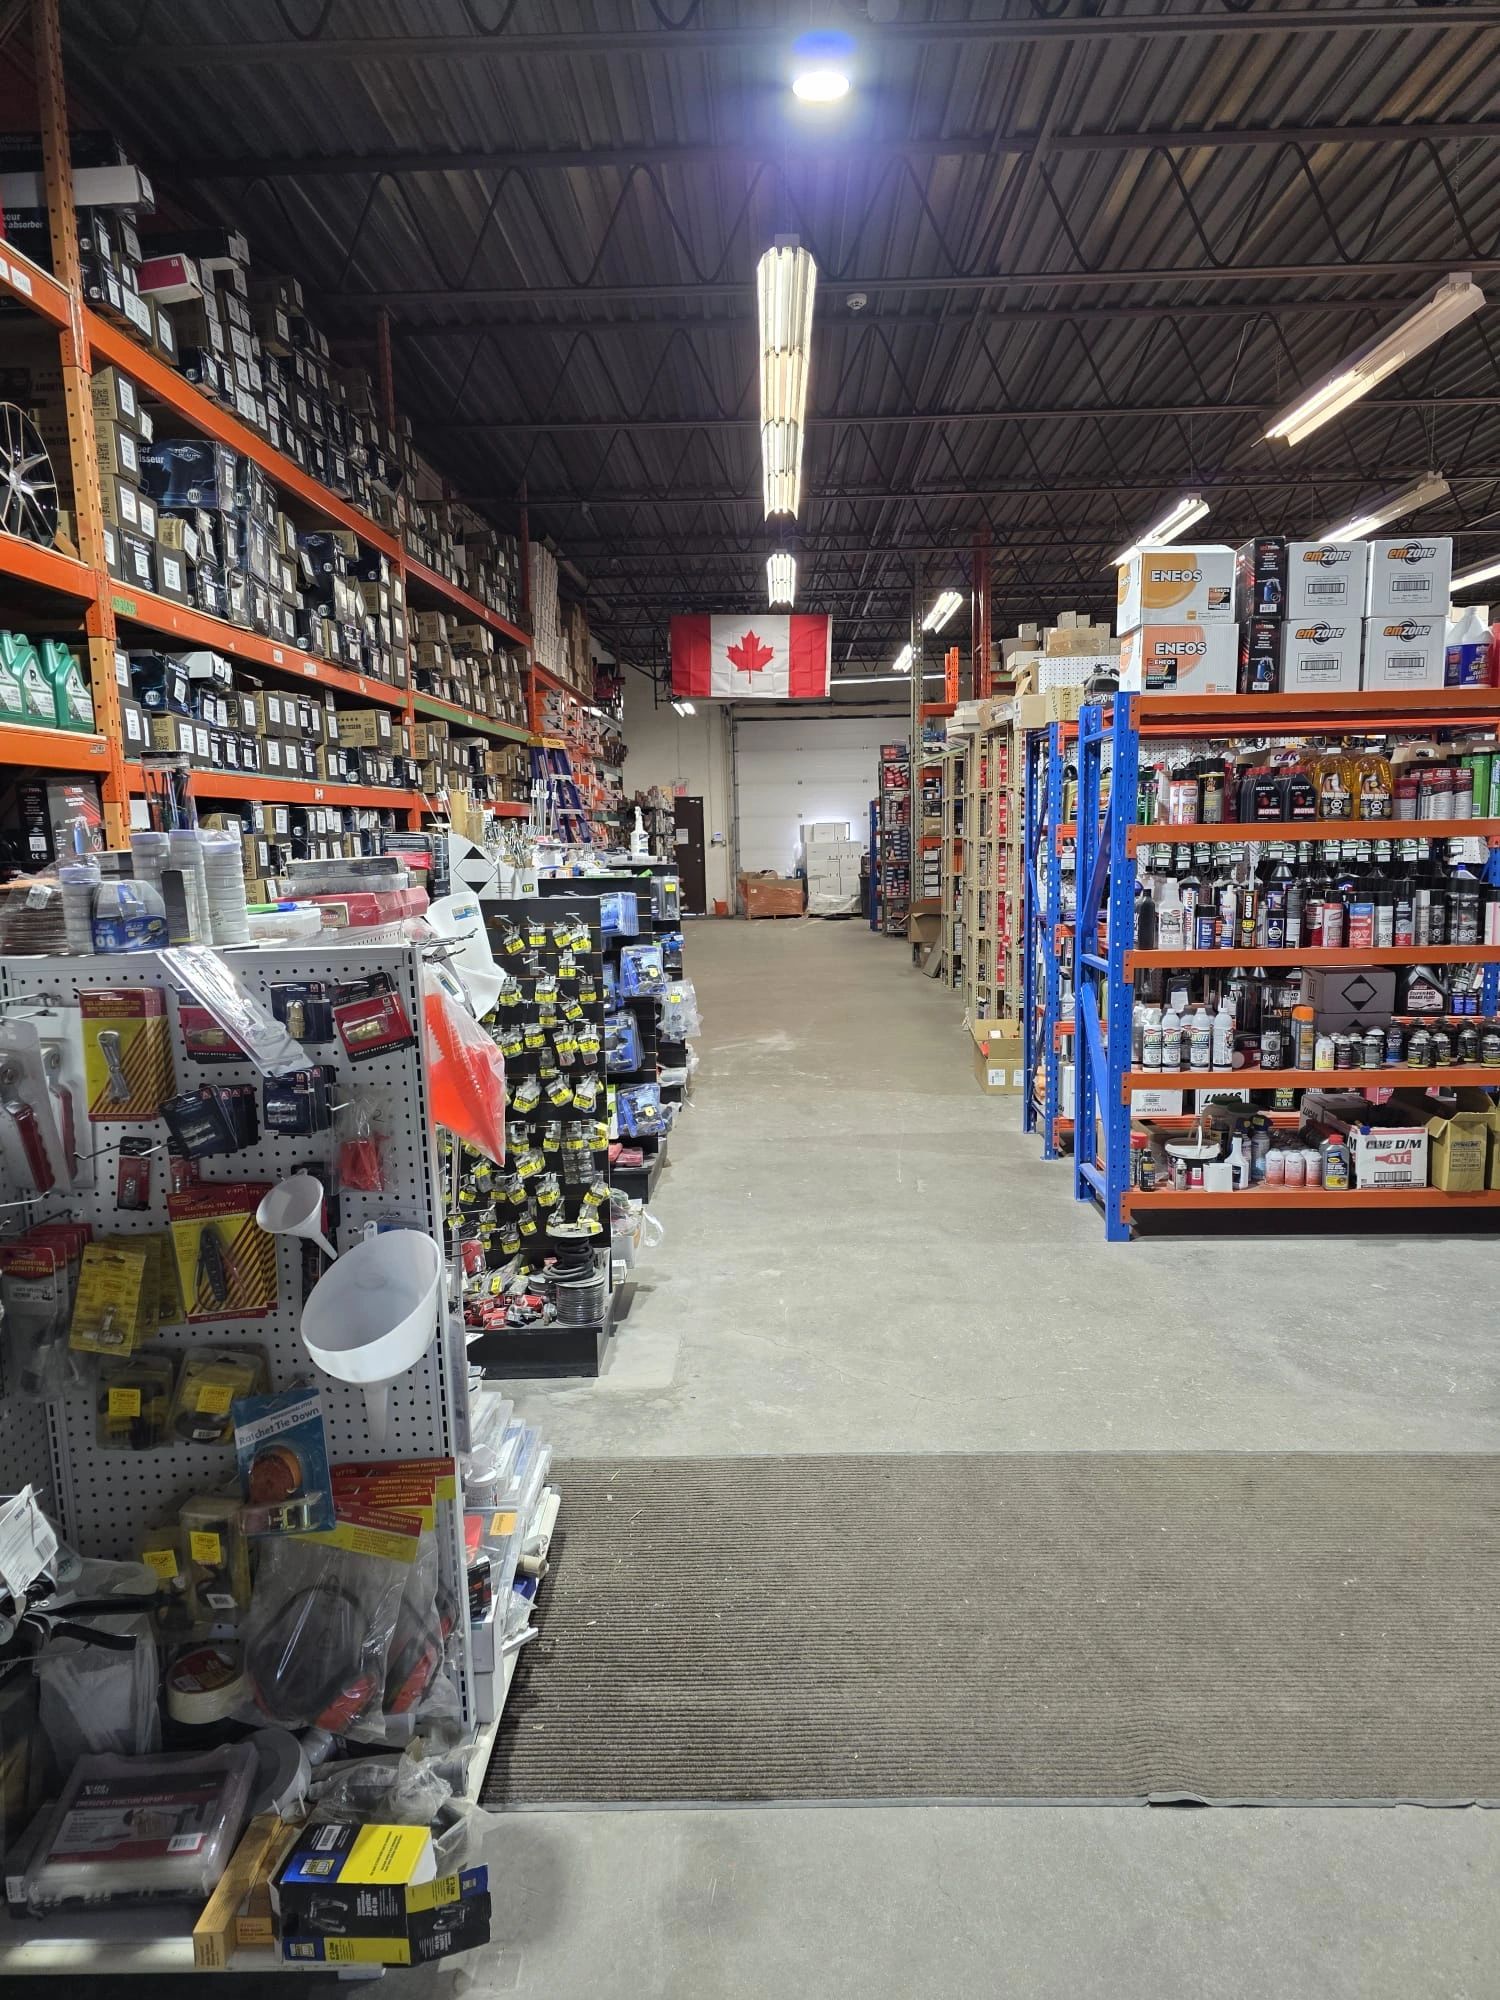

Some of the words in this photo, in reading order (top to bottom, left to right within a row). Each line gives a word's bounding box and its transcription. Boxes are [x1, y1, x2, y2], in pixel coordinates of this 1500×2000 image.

[1303, 550, 1351, 563] emzone
[1388, 547, 1436, 560] emzone
[1151, 570, 1202, 582] ENEOS
[1295, 627, 1345, 640] emzone
[1383, 625, 1431, 637] emzone
[1155, 642, 1207, 655] ENEOS
[1395, 1139, 1421, 1149] D/M
[1388, 1154, 1411, 1163] ATF
[239, 1425, 274, 1446] Ratchet
[275, 1420, 290, 1430] Tie
[291, 1408, 319, 1423] Down
